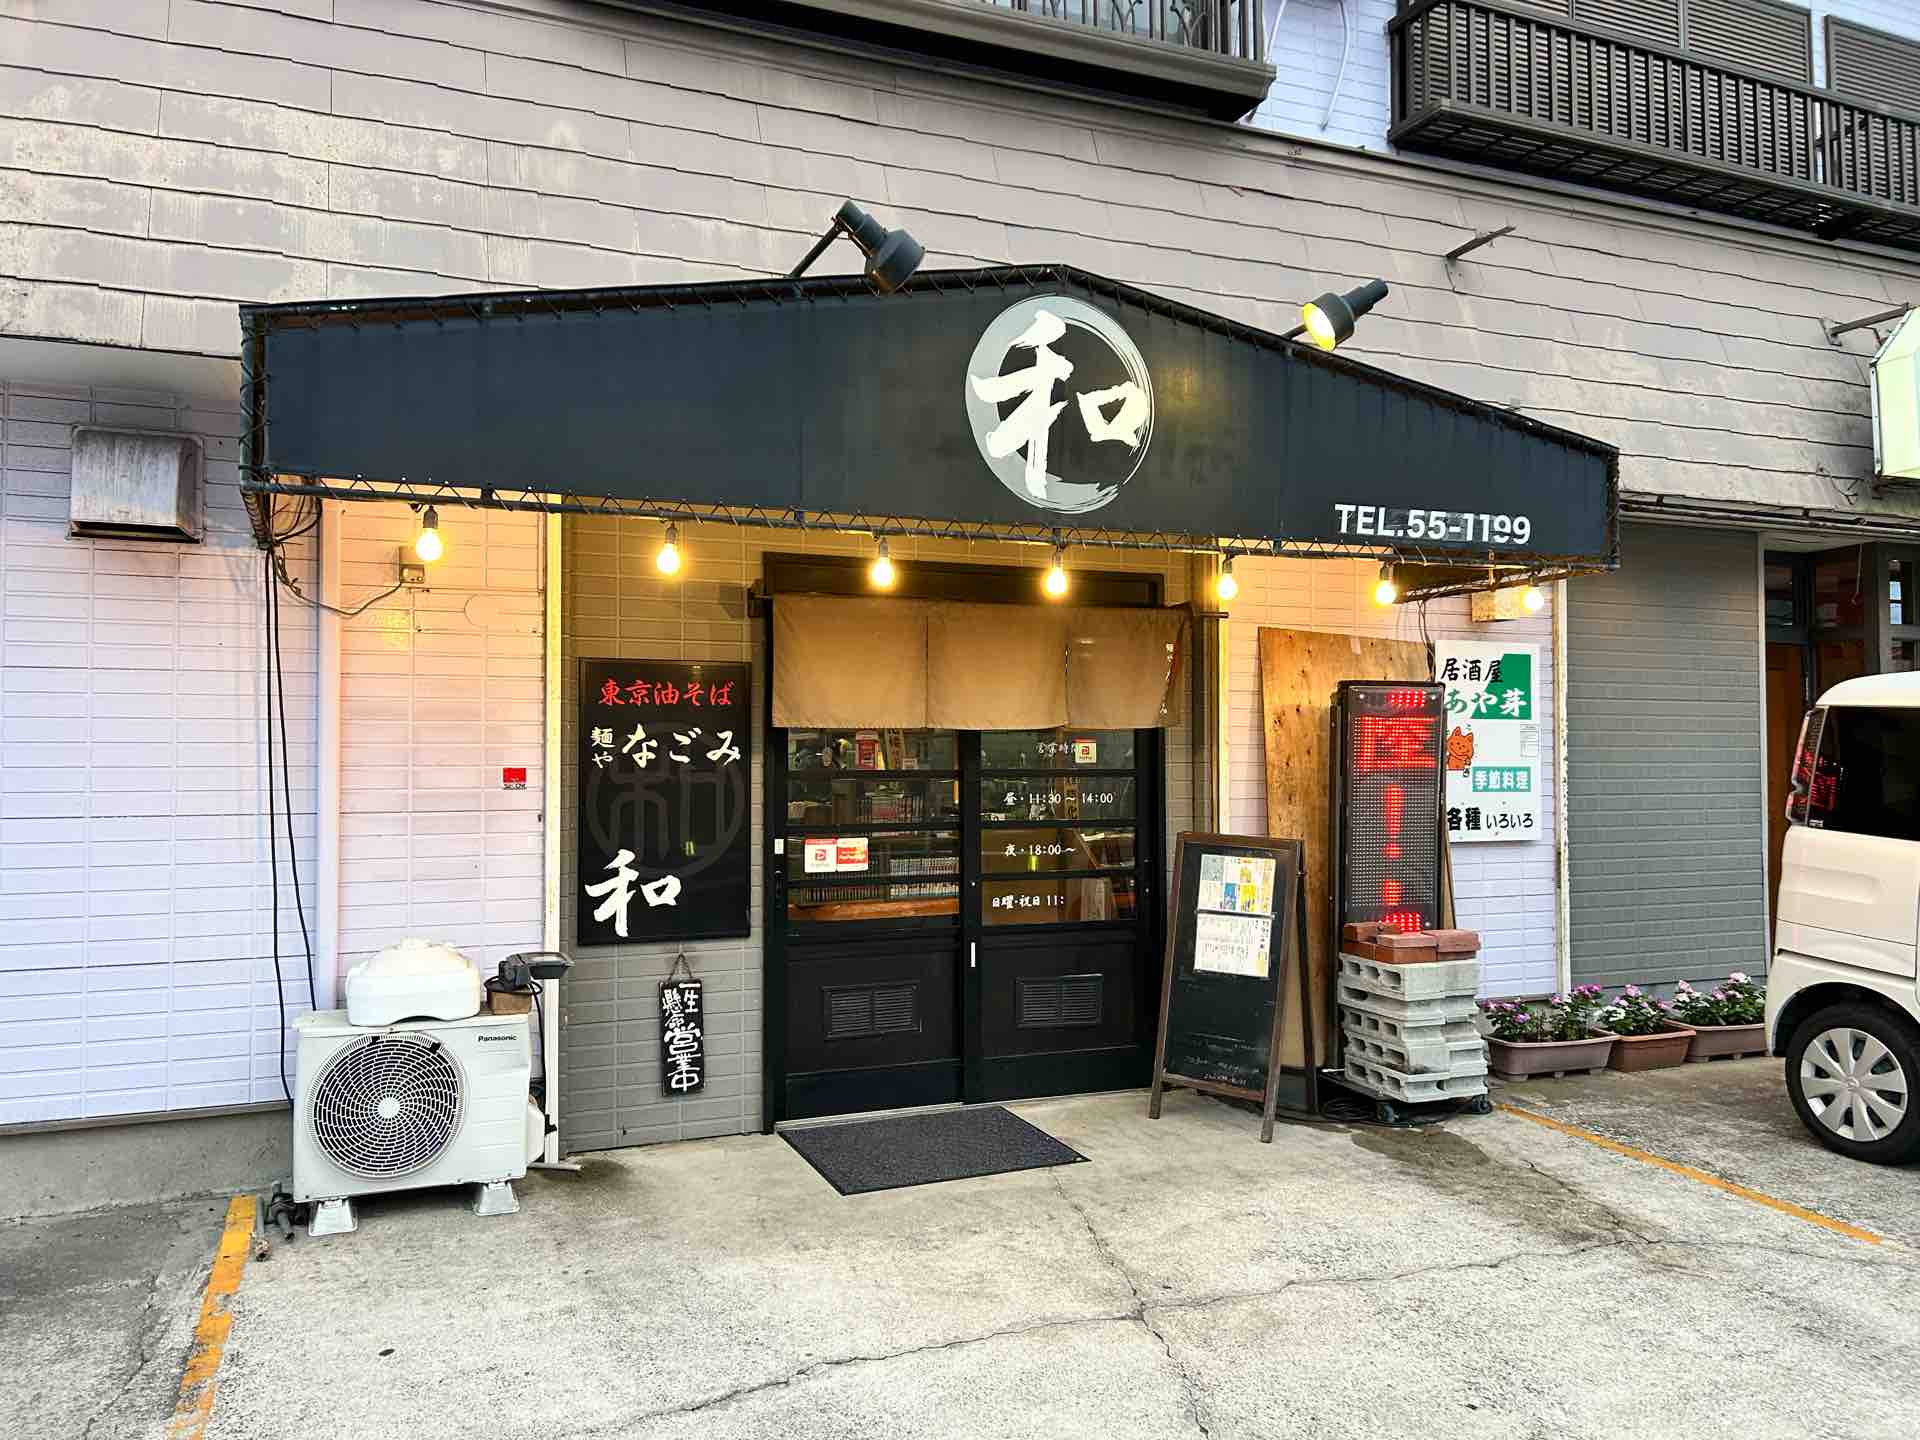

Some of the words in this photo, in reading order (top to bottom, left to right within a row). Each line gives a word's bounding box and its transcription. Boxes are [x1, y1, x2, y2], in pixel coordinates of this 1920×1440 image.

[970, 309, 1149, 499] 和
[1440, 657, 1504, 683] 居酒屋
[599, 678, 736, 706] 東京油そば
[621, 723, 741, 768] なごみ
[1474, 769, 1529, 790] 季節料理
[1486, 813, 1534, 829] いろいろ
[584, 848, 682, 938] 和
[478, 1034, 518, 1042] Panasonic
